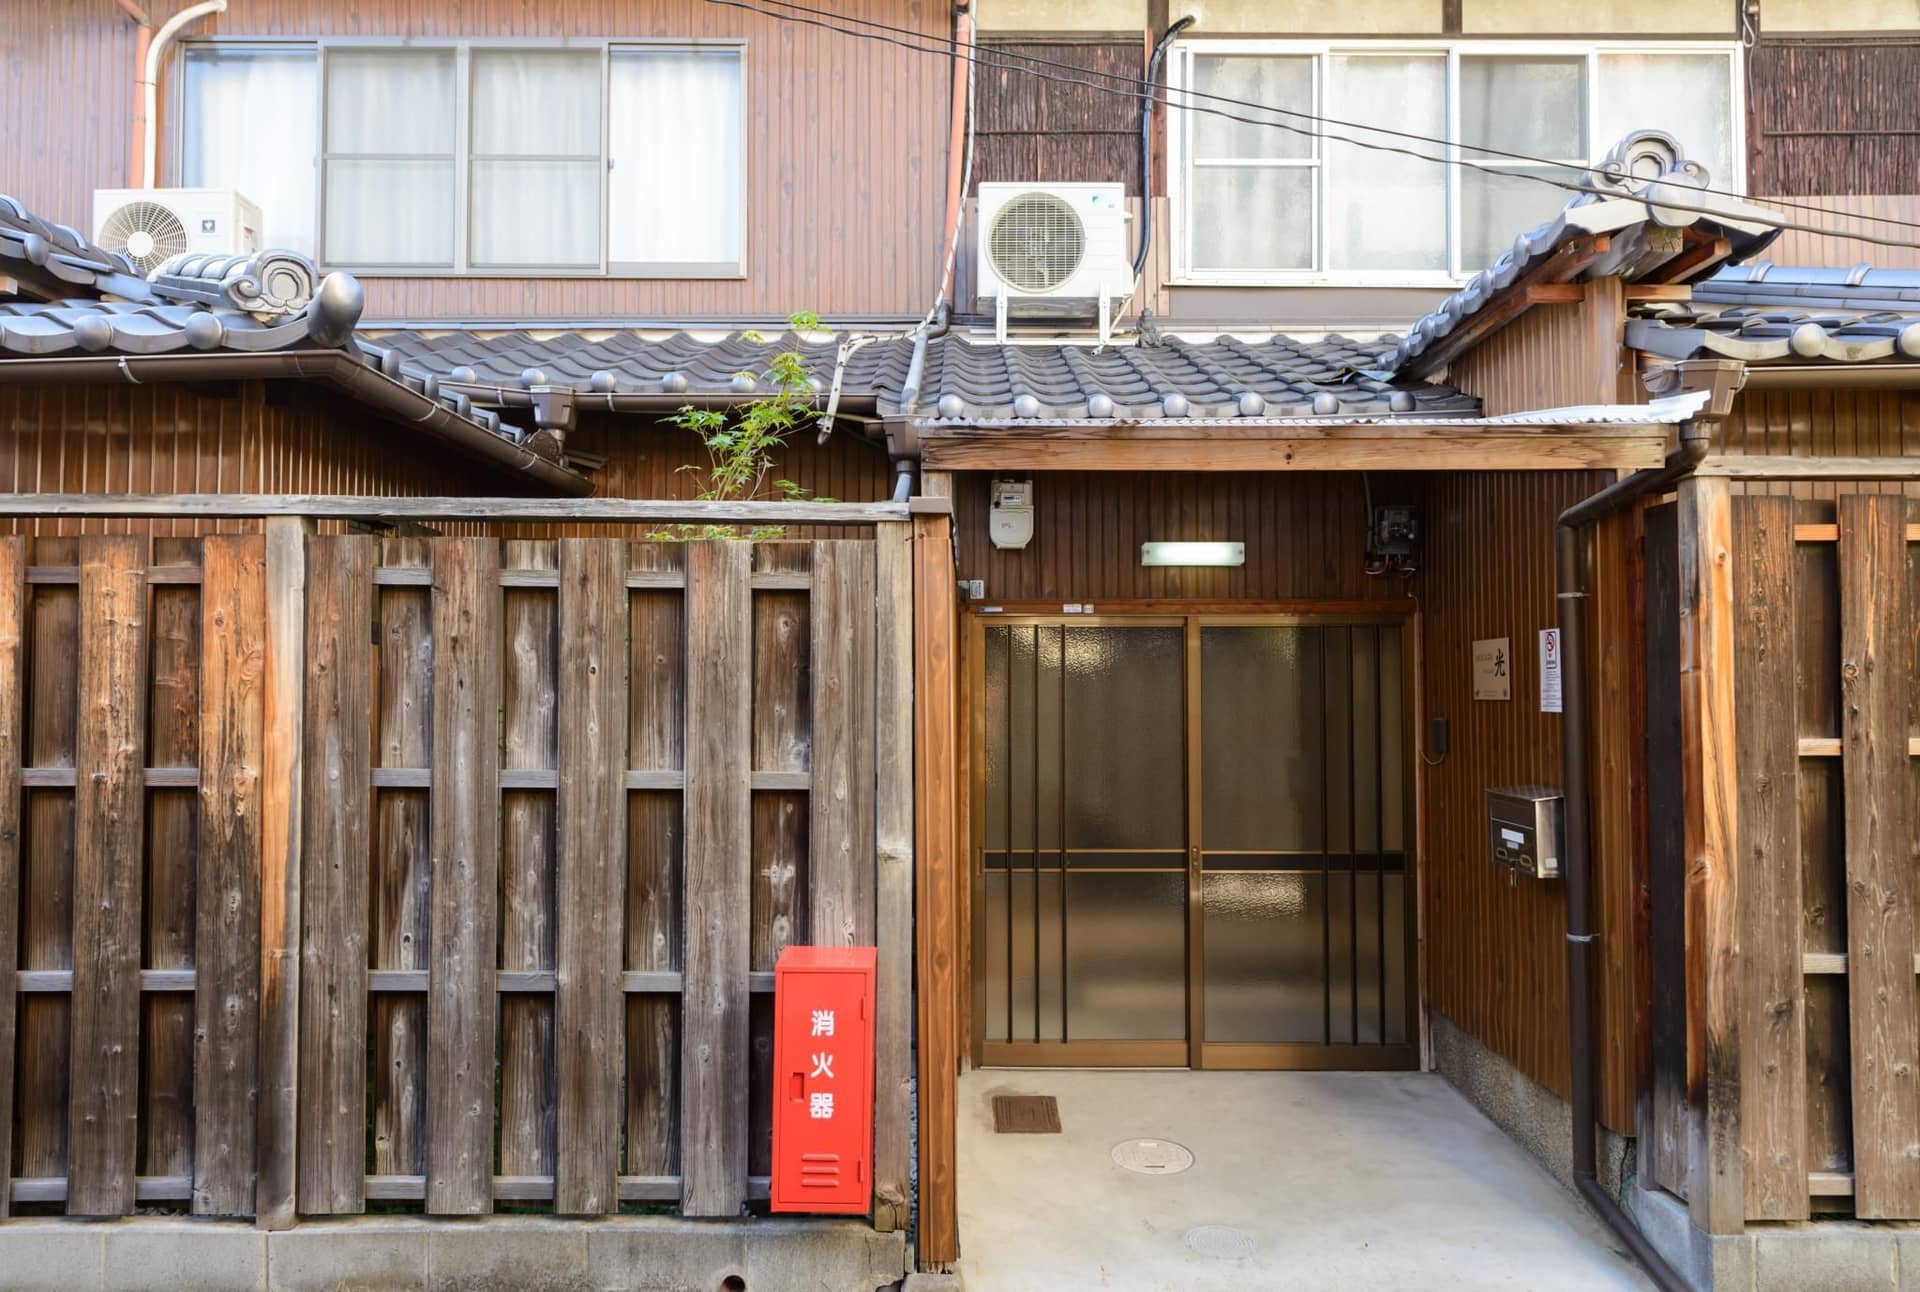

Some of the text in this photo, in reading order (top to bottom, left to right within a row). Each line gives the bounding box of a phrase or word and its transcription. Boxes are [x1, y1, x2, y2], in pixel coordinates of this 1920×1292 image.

[1494, 648, 1506, 677] 光
[809, 1009, 835, 1119] 消火器
